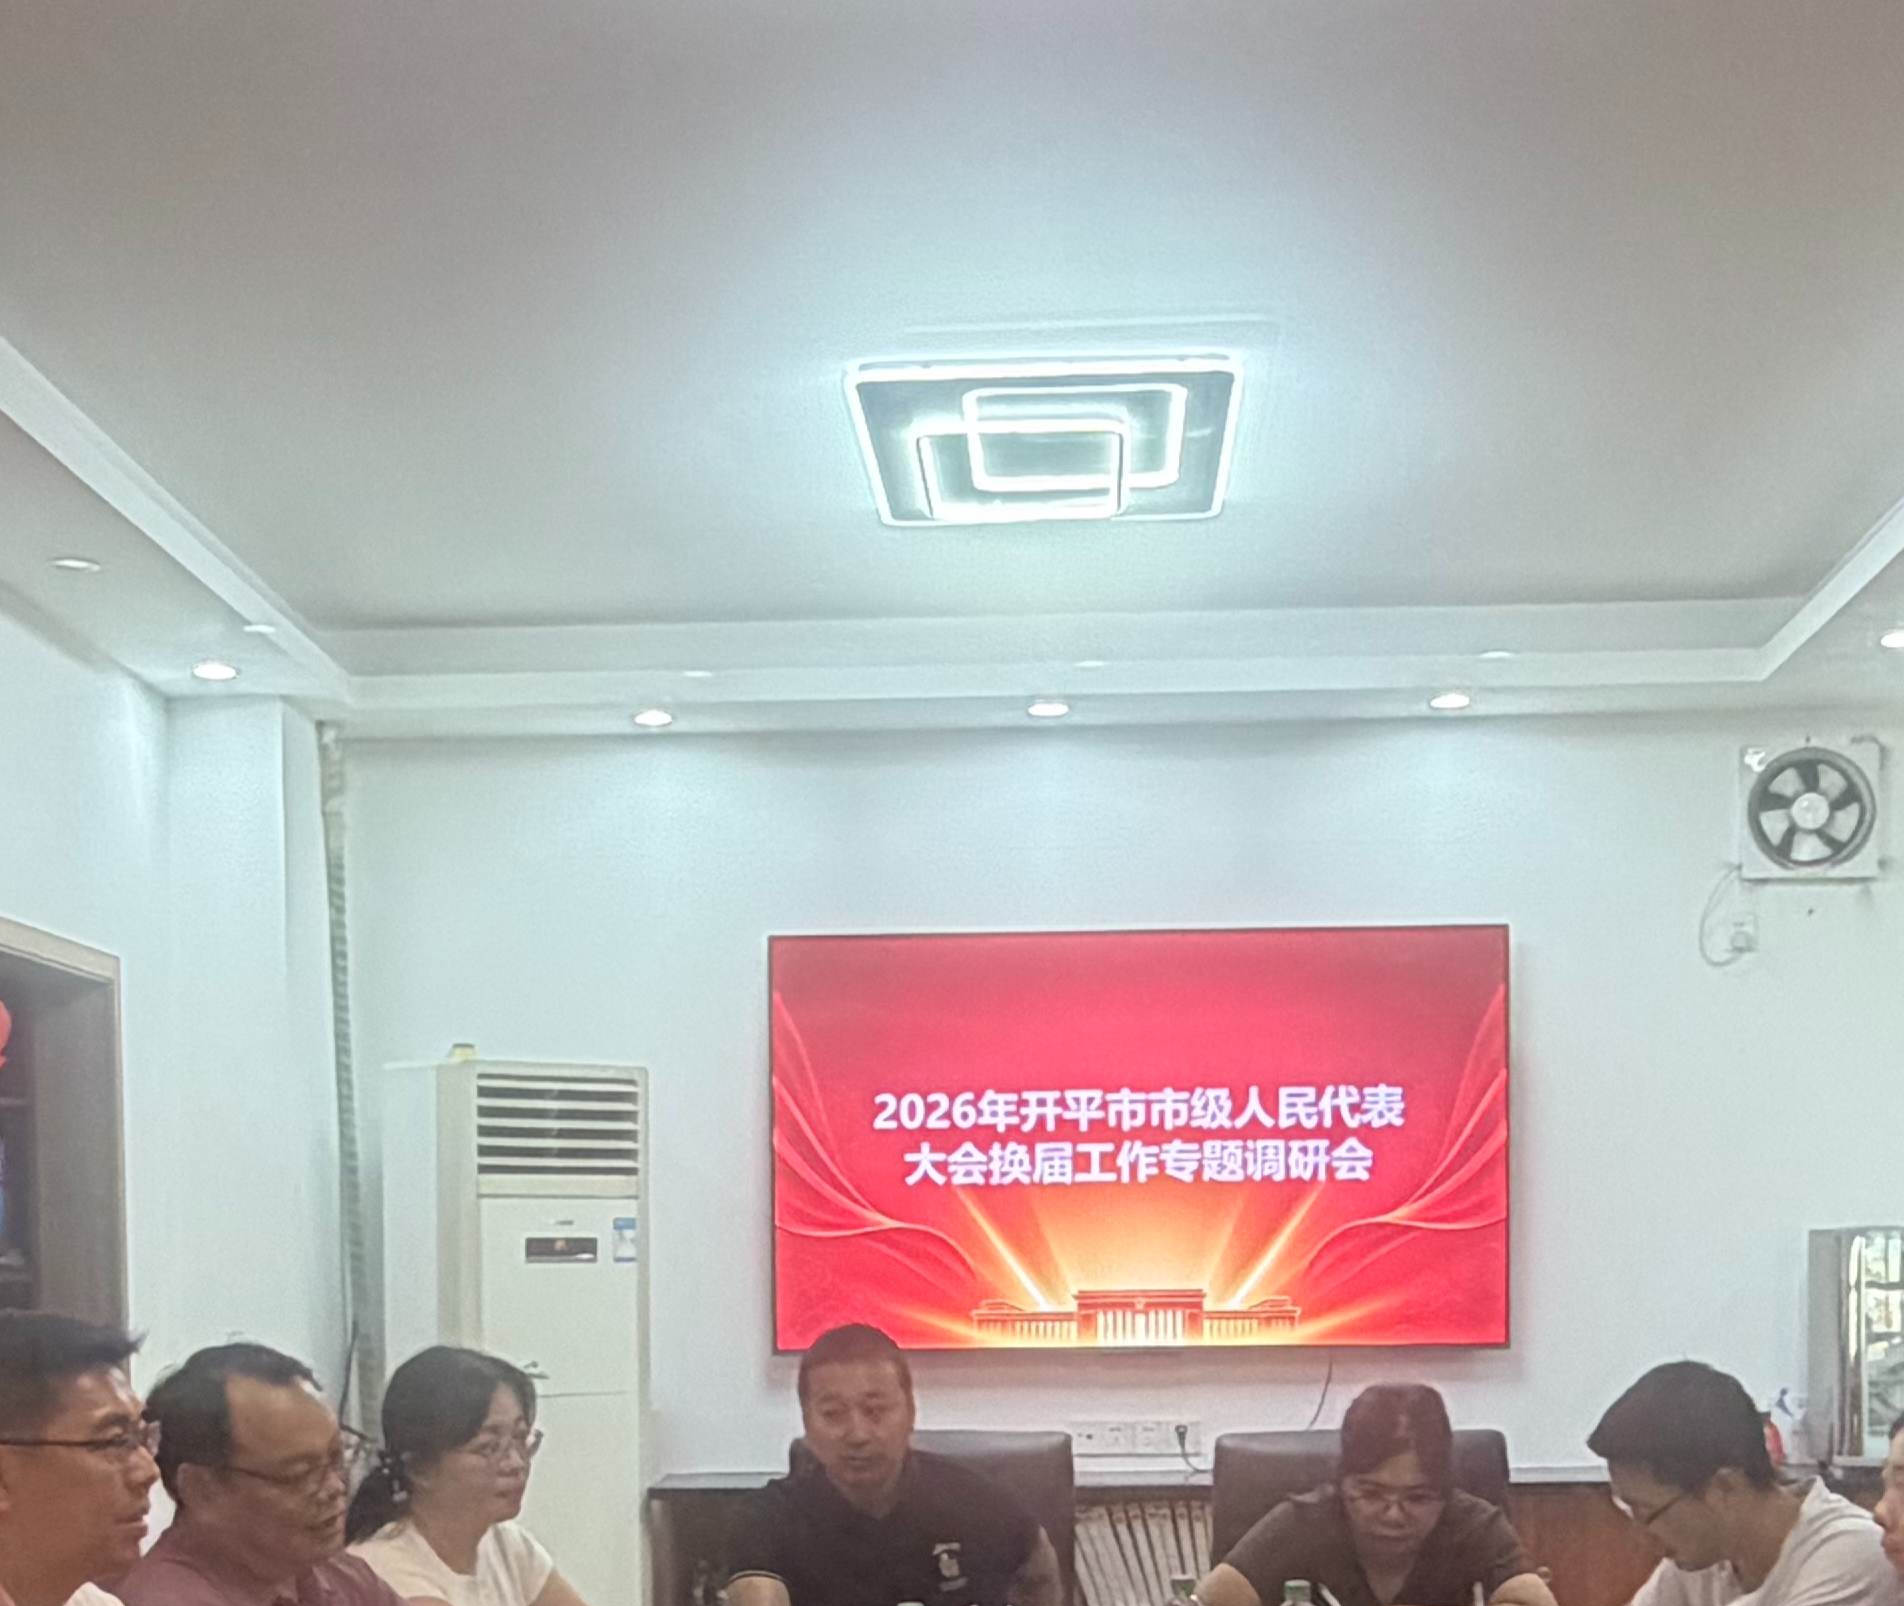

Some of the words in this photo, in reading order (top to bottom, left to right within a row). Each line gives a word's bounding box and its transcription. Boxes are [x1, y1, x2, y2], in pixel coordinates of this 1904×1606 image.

[872, 1084, 1405, 1133] 2026年开平市市级人民代表
[903, 1137, 1374, 1187] 大会换届工作专题调研会
